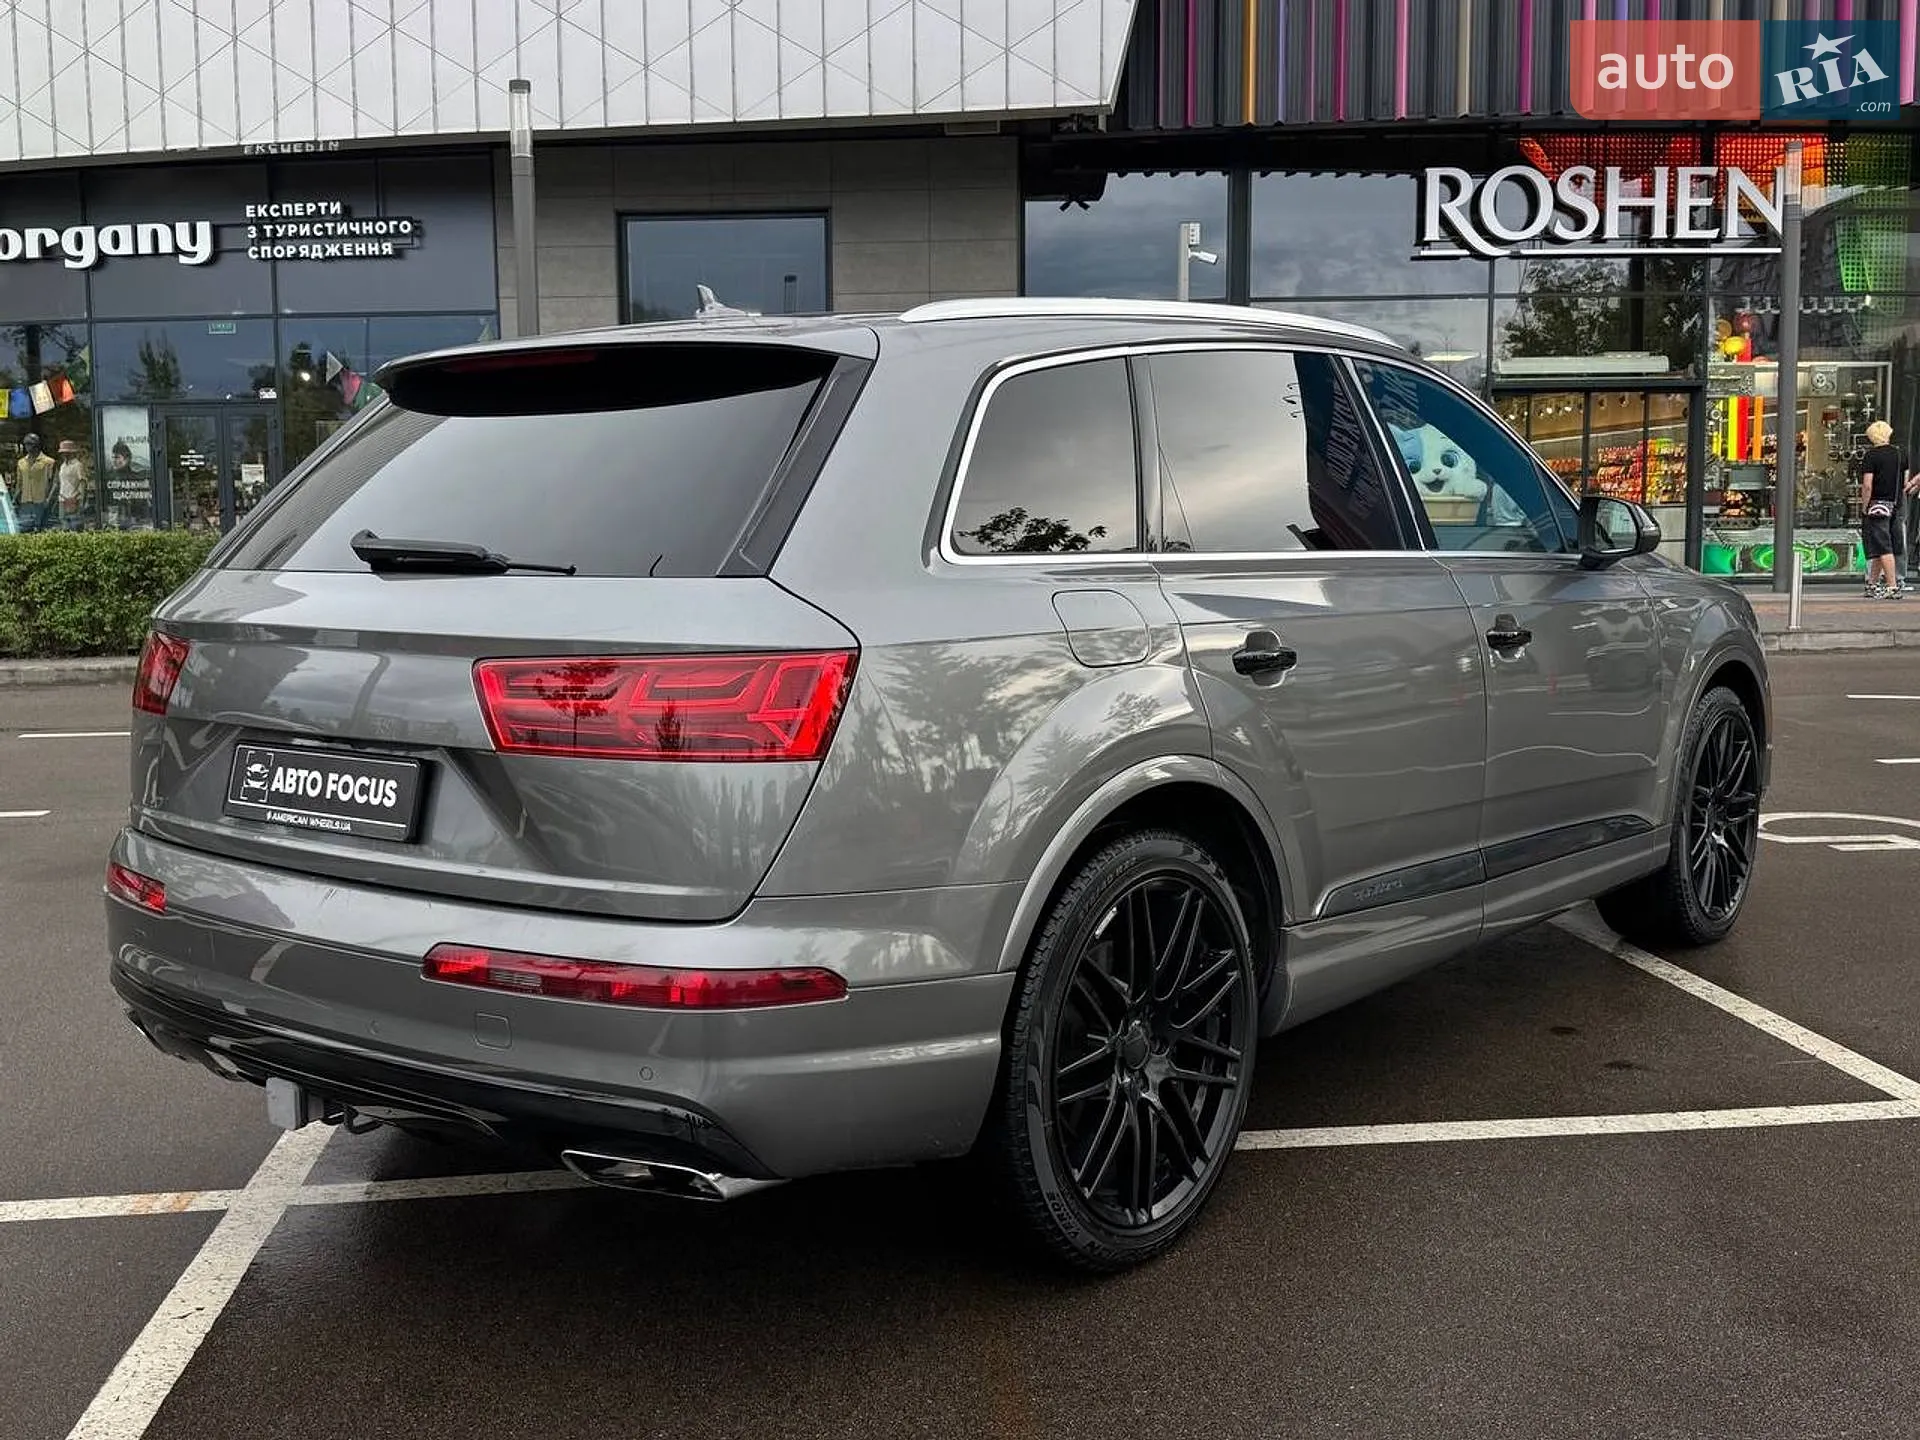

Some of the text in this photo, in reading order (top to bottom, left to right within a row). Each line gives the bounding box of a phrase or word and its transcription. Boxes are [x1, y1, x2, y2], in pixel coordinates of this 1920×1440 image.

[245, 201, 342, 218] ЕКСПЕРТИ
[1423, 165, 1784, 256] ROSHEN
[263, 220, 412, 238] ТУРИСТИЧНОГО
[0, 220, 212, 269] organy
[248, 242, 394, 259] СПОРЯДЖЕННЯ
[270, 766, 398, 808] АВТО FOCUS
[271, 811, 308, 825] AMERICAN
